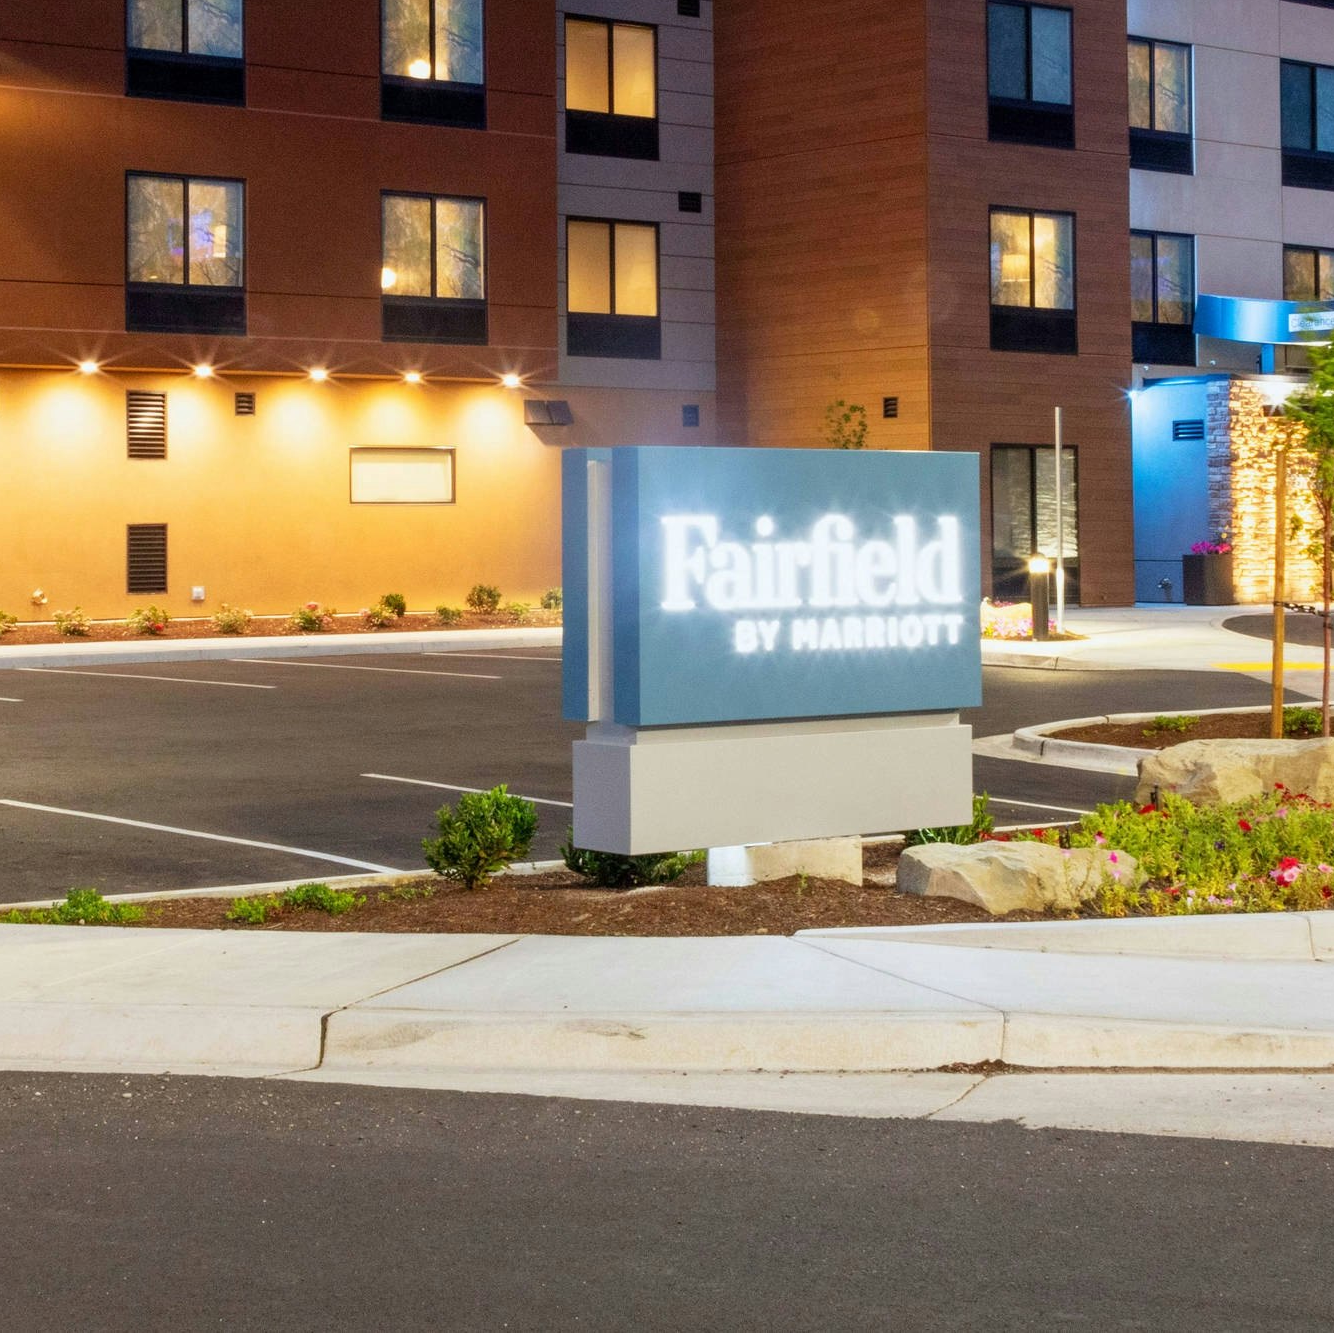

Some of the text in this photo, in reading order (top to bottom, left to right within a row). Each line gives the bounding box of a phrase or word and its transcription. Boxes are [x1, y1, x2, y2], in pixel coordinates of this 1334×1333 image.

[661, 513, 964, 611] Fairfield
[734, 614, 965, 654] BY MARRIOTT
